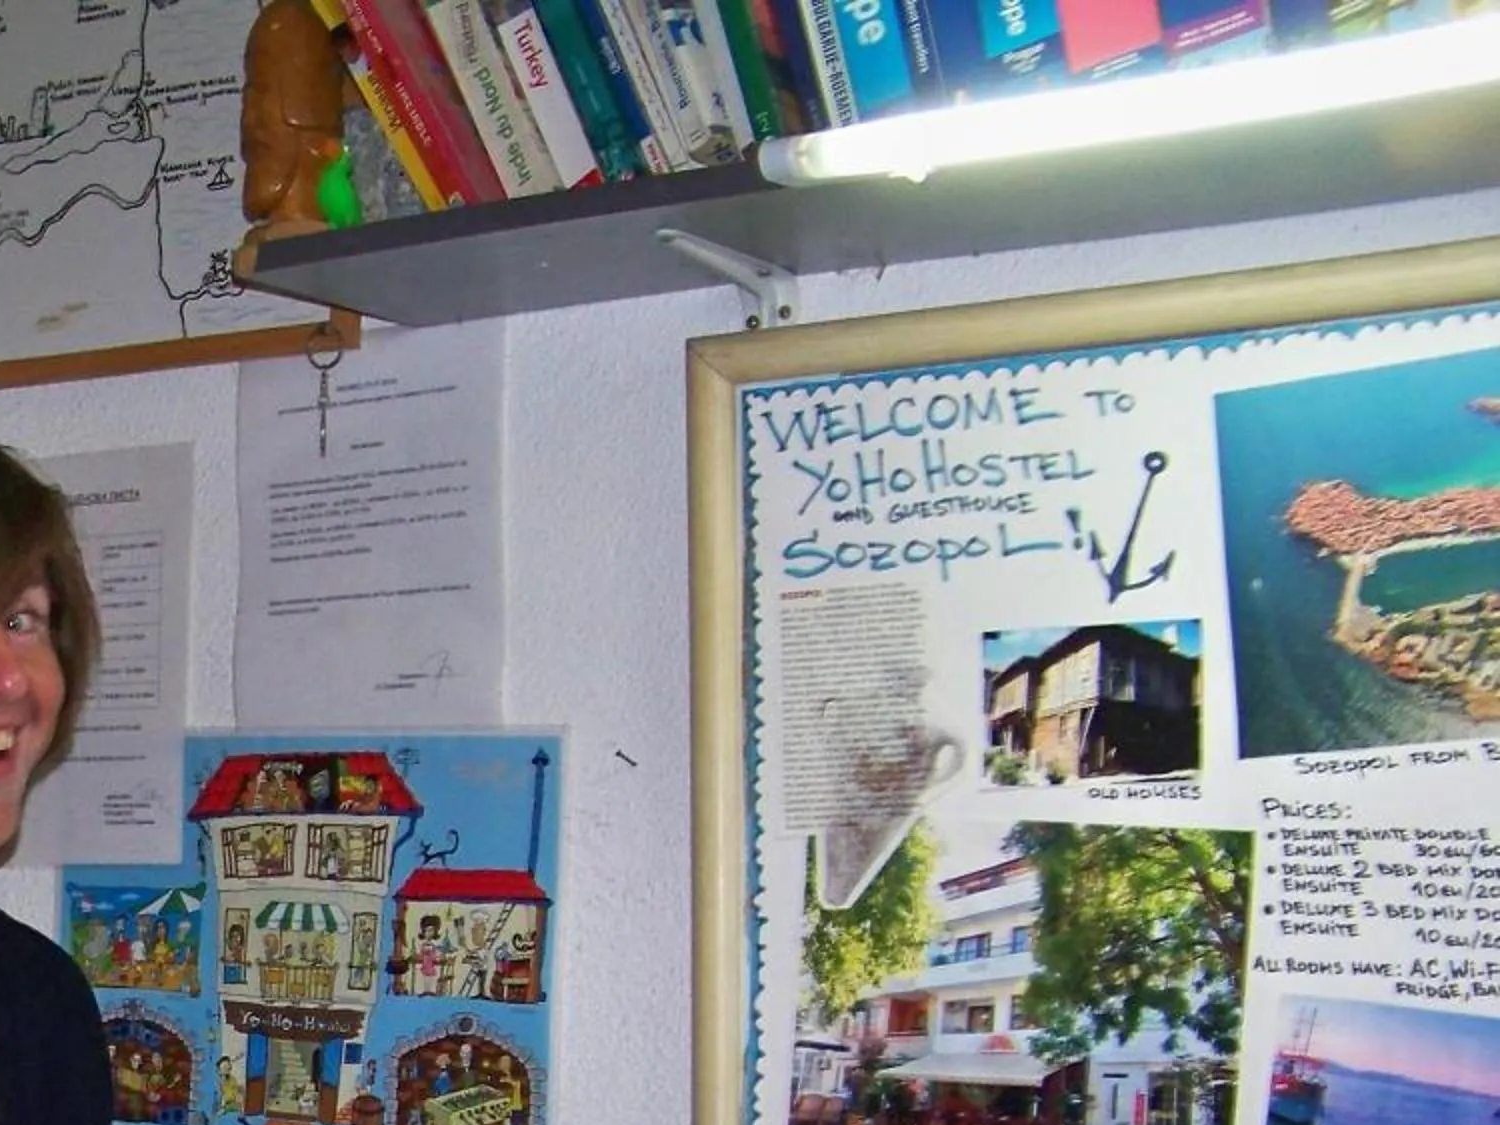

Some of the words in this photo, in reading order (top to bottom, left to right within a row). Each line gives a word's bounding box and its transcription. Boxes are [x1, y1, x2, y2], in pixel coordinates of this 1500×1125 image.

[513, 17, 549, 89] Turkey
[472, 66, 501, 116] Nord
[496, 113, 516, 141] du
[507, 142, 533, 187] Inde
[761, 387, 1065, 453] WELCOME
[887, 492, 1040, 525] GUESTHOUSE
[1407, 749, 1472, 766] FROM
[1086, 784, 1120, 801] OLD
[1126, 783, 1202, 801] HOUSES
[1413, 827, 1492, 843] DOUBLE
[1282, 862, 1346, 877] DELUXE
[1351, 859, 1373, 879] 2
[1376, 862, 1419, 877] BED
[1279, 900, 1358, 918] DELUXE
[1361, 900, 1379, 917] 3
[1384, 903, 1426, 920] BED
[1252, 955, 1282, 976] ALL
[1285, 957, 1344, 975] ROOMS
